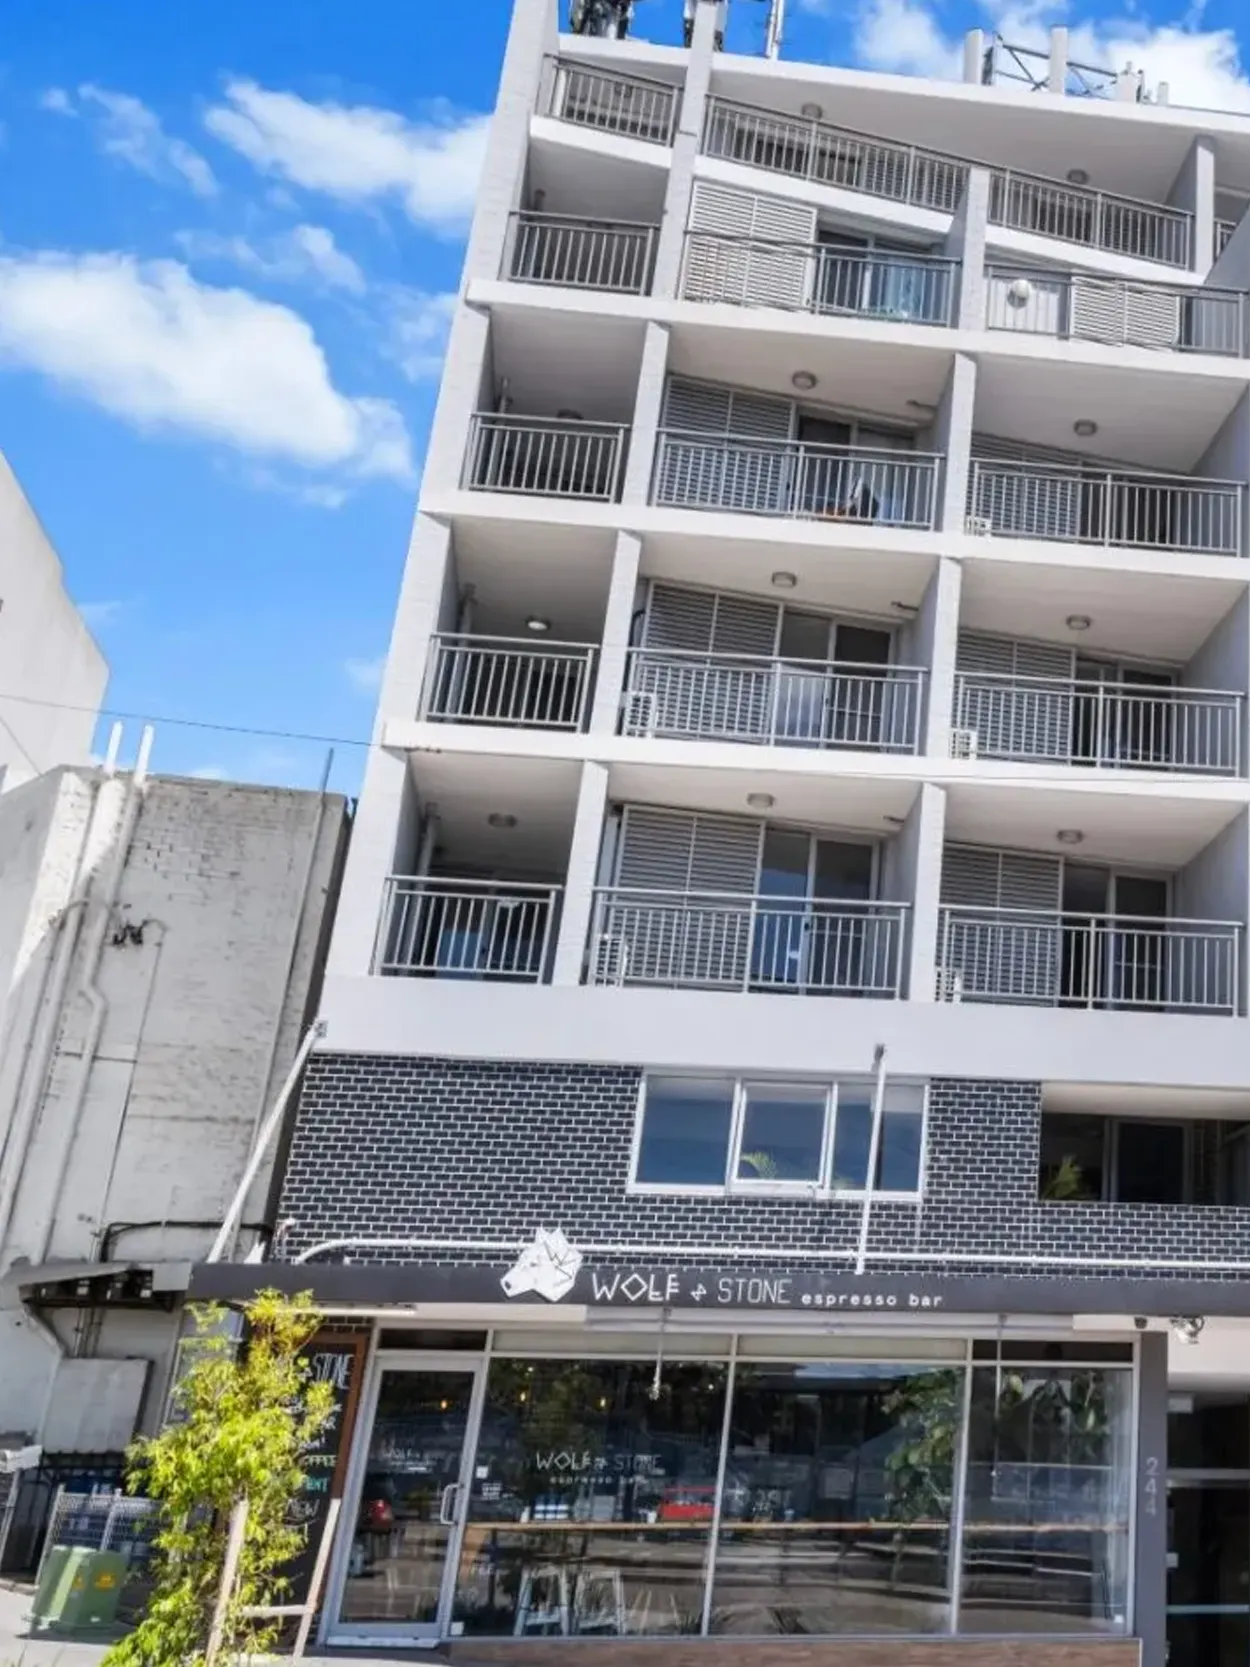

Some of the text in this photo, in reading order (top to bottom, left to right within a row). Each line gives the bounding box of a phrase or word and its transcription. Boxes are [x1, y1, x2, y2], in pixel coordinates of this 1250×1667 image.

[591, 1272, 680, 1302] WOLF
[718, 1277, 793, 1304] STONE
[802, 1292, 897, 1307] espresso
[909, 1293, 943, 1307] bar
[536, 1450, 591, 1471] WOLF
[1144, 1456, 1159, 1516] 244
